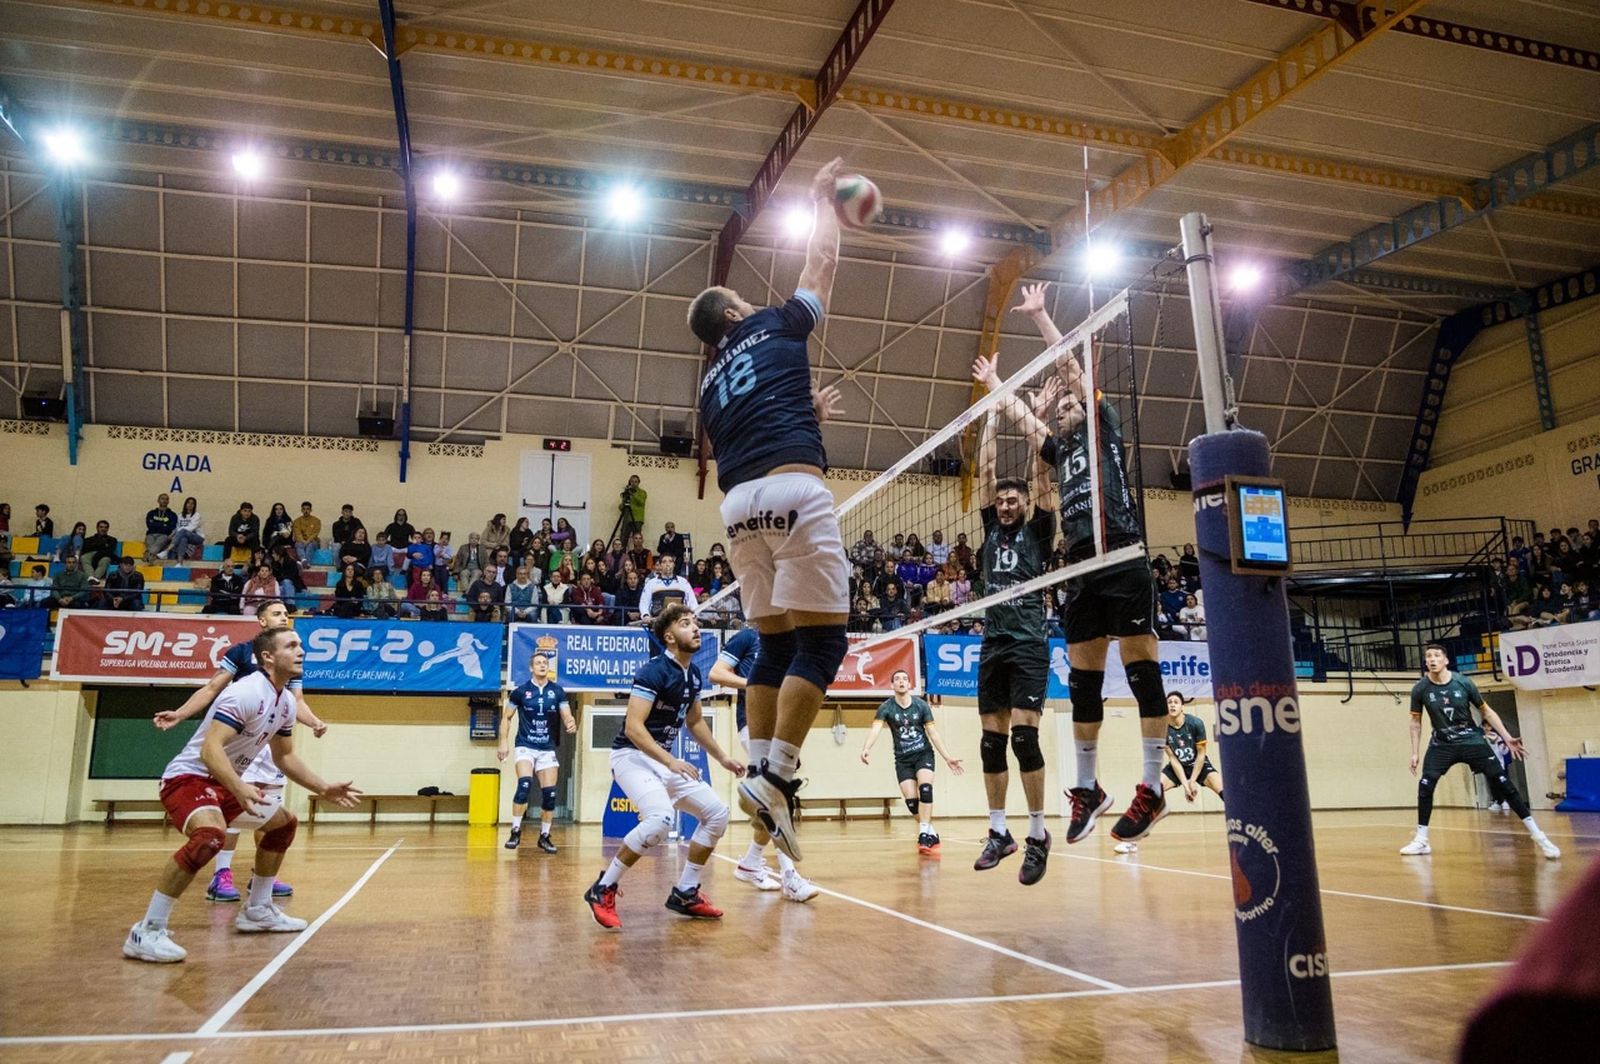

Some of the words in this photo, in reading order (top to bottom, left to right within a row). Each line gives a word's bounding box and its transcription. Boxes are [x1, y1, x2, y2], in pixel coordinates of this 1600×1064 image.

[715, 353, 757, 409] 18
[142, 453, 212, 472] GRADA
[1063, 446, 1087, 483] 15
[170, 476, 183, 493] A
[992, 547, 1019, 572] 19
[102, 630, 198, 657] SM-2
[305, 628, 414, 663] SF-2
[567, 635, 593, 651] REAL
[597, 636, 650, 652] FEDERACI
[100, 659, 136, 668] SUPERLIGA
[137, 660, 168, 669] VOLEIBOL
[169, 661, 207, 669] MASCULINA
[566, 656, 620, 675] ESPAÑOLA
[623, 661, 636, 676] DE
[938, 643, 982, 672] SF
[1160, 655, 1209, 677] erife
[303, 669, 350, 679] SUPERLIGA
[352, 670, 397, 680] FEMENINA
[398, 671, 404, 681] 2
[937, 678, 975, 688] SUPERLIGA
[1443, 707, 1454, 721] 7
[900, 726, 918, 738] 24
[1175, 747, 1195, 761] 23
[1245, 824, 1279, 854] alter
